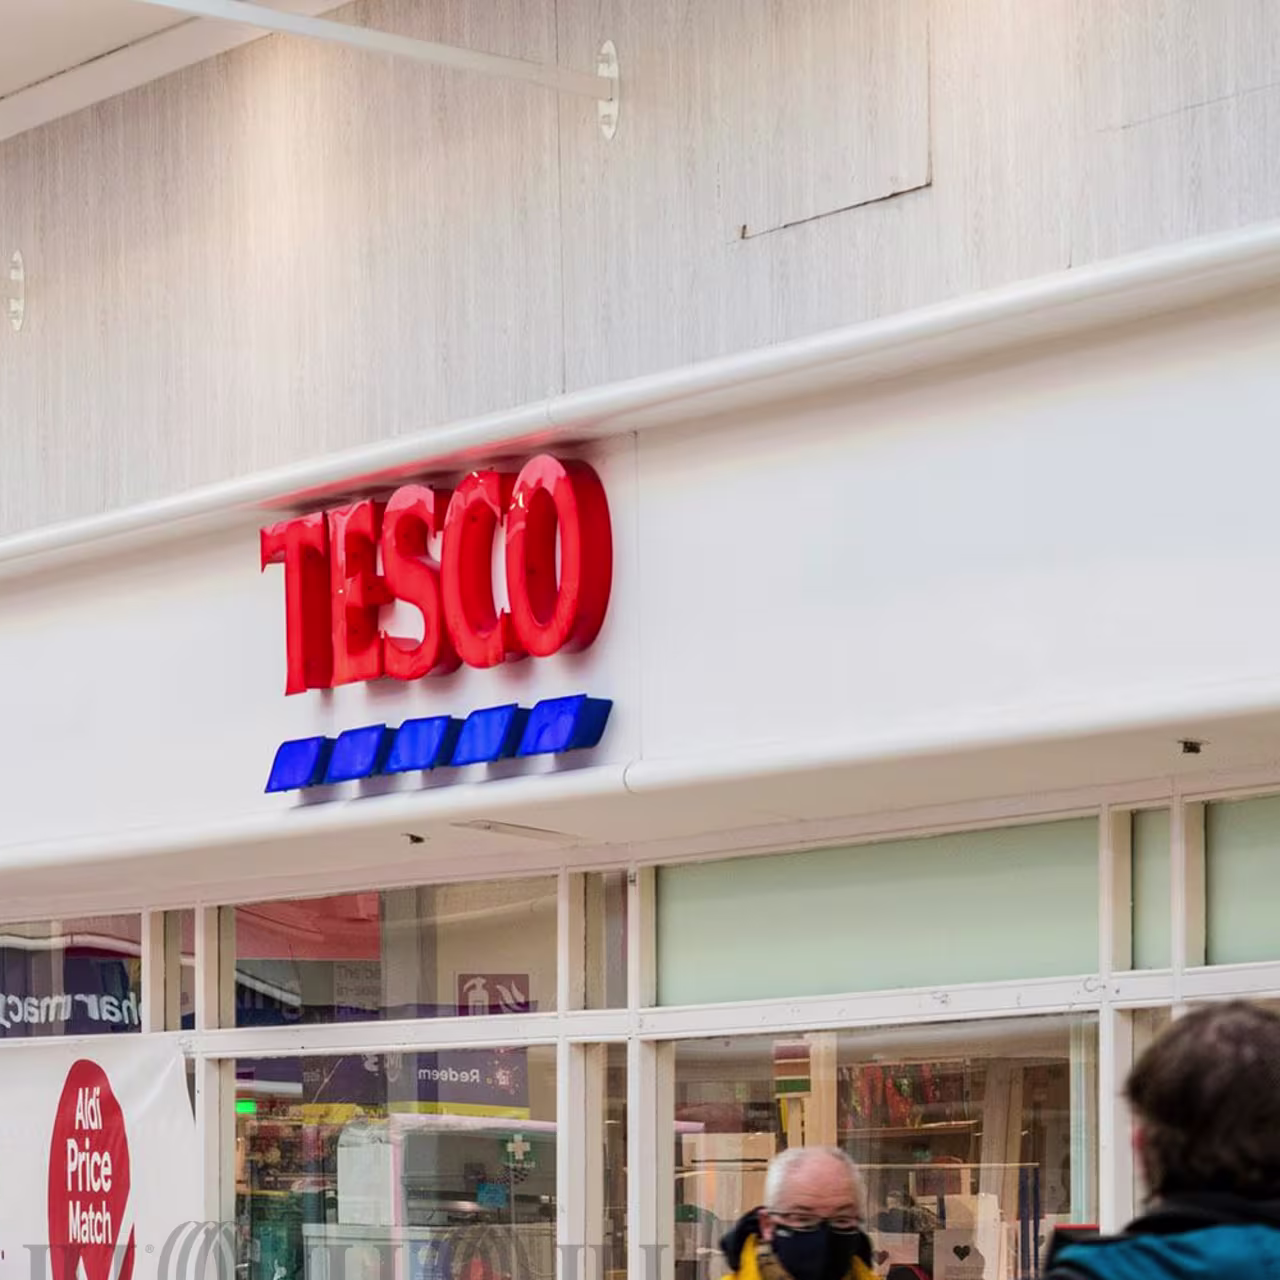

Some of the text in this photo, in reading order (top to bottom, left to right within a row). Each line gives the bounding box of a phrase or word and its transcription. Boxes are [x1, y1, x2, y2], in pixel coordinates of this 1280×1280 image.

[260, 454, 608, 697] TESCO
[75, 1087, 104, 1131] Aldi
[66, 1138, 112, 1193] Price
[68, 1200, 112, 1245] Match
